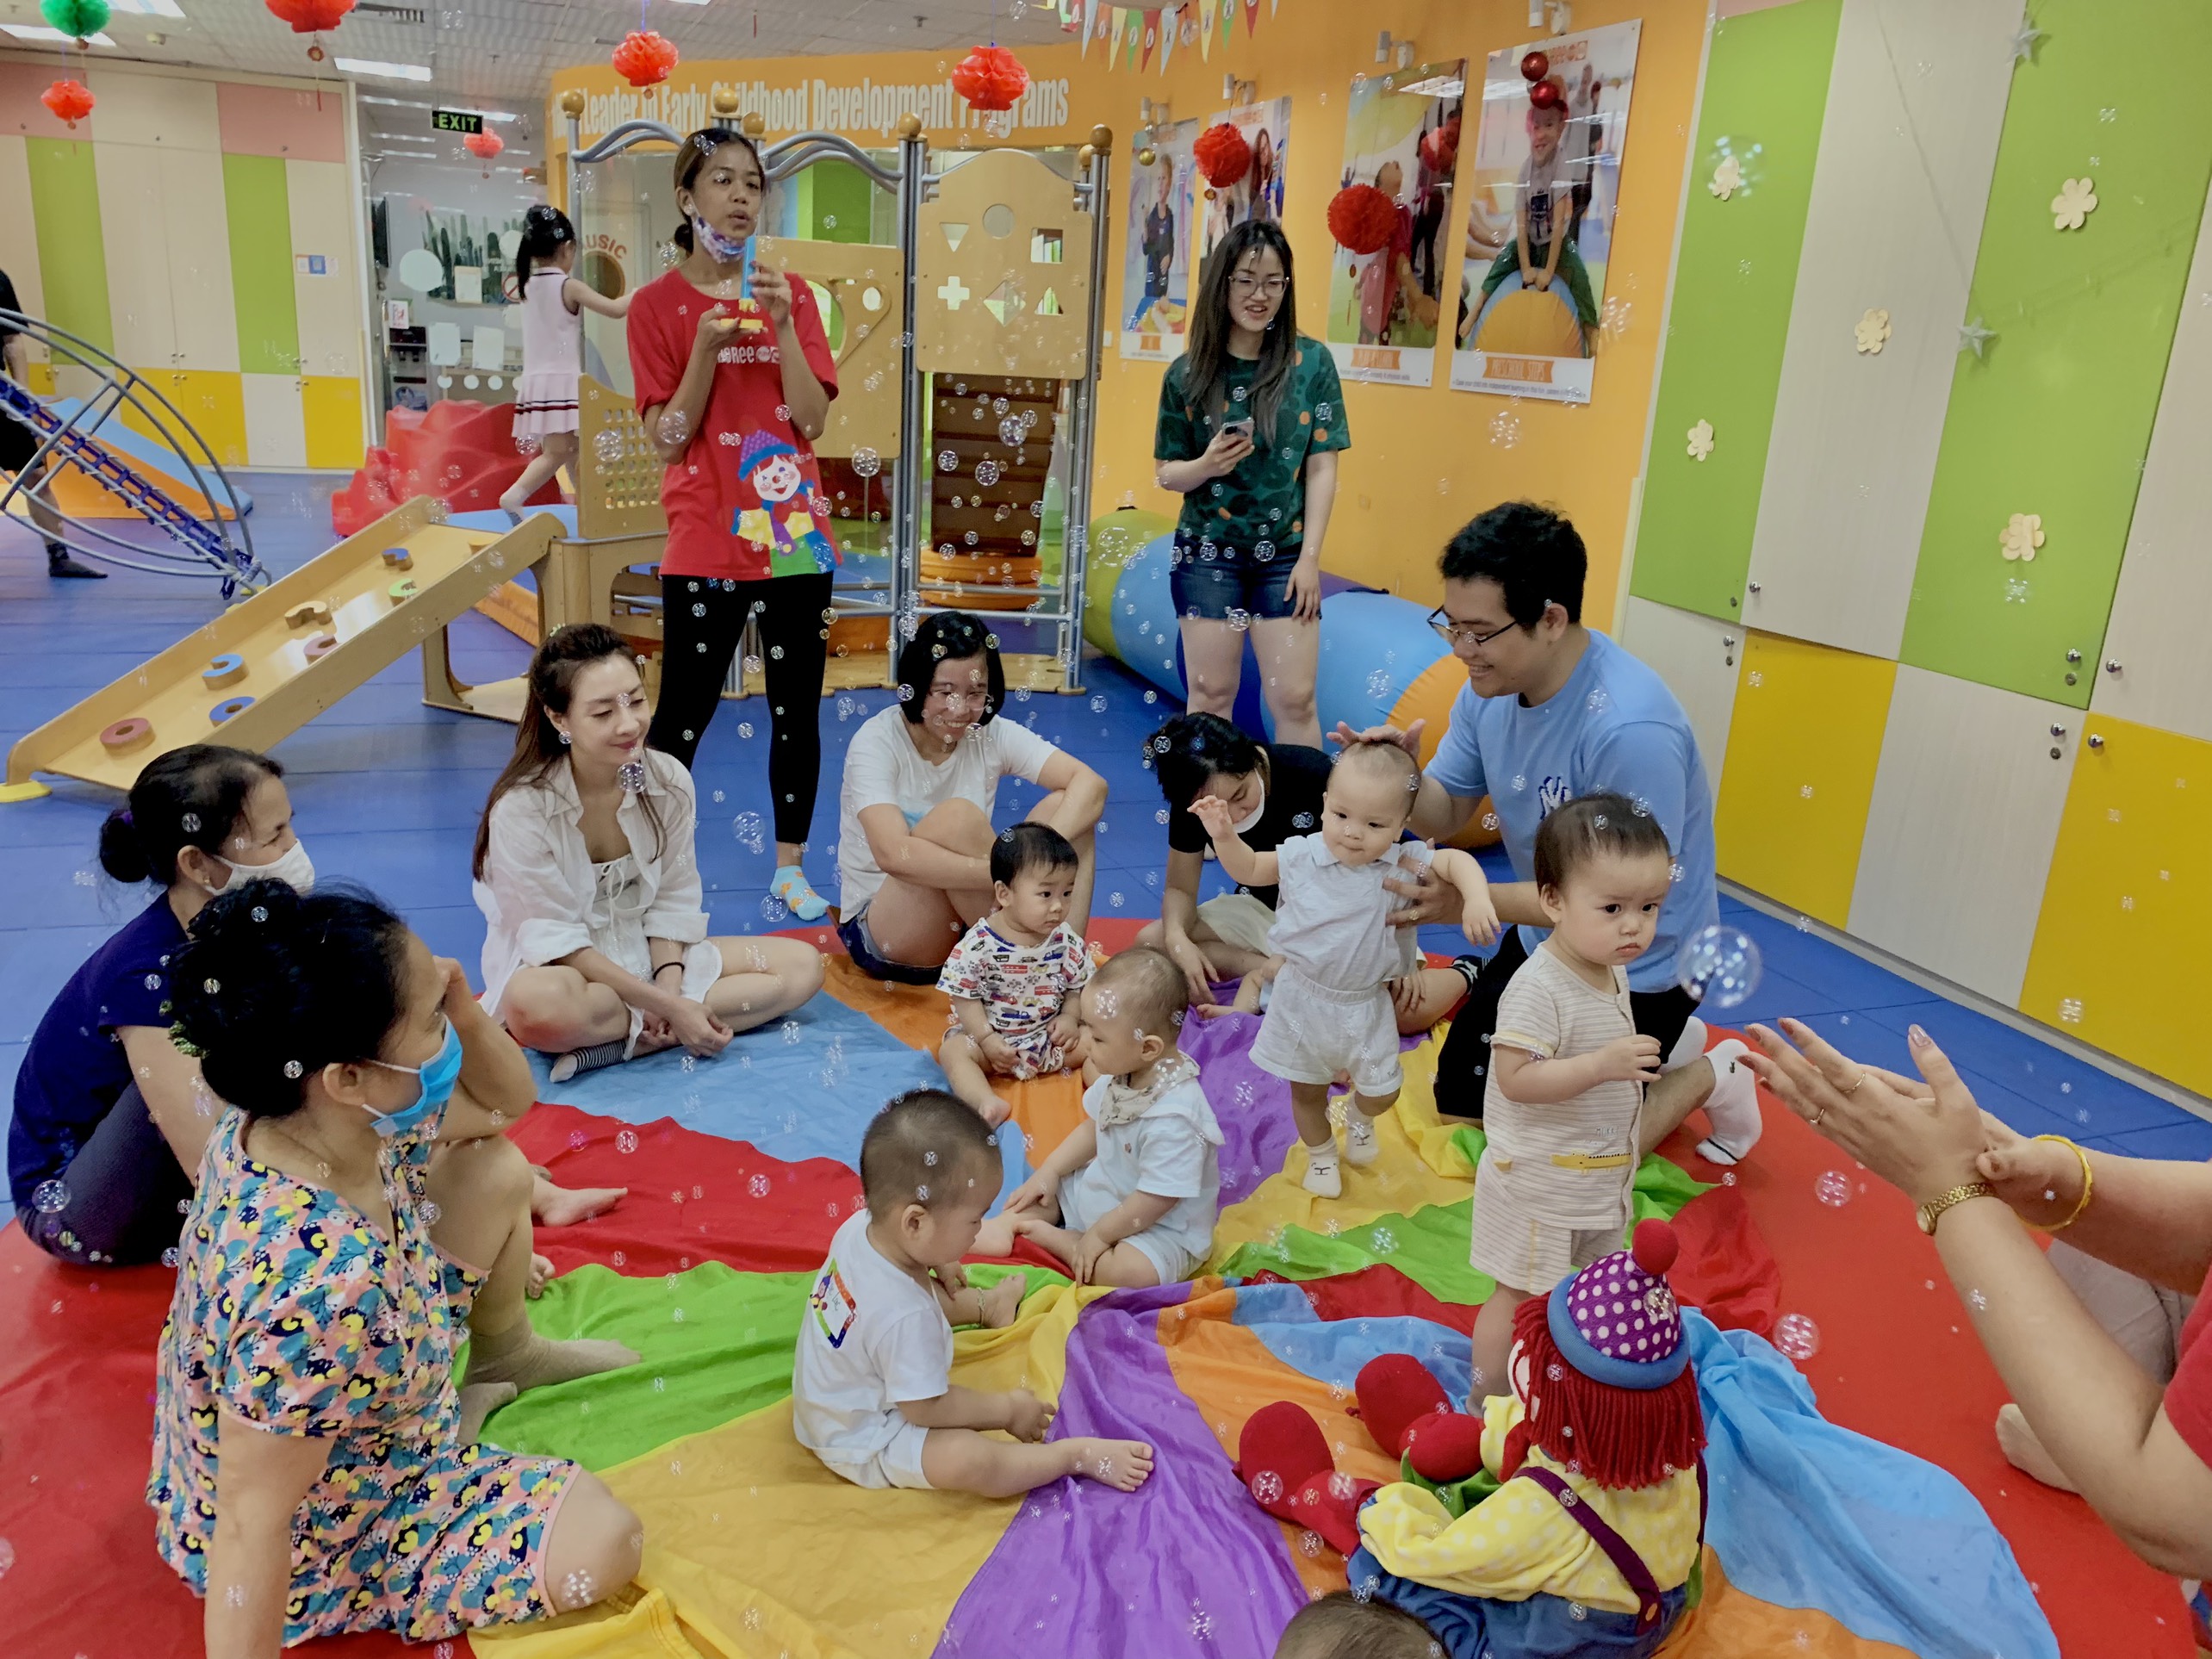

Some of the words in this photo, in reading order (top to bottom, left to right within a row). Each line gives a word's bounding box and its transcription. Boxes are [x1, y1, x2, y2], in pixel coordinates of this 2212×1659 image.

[582, 85, 638, 135] Leader
[661, 83, 707, 134] Early
[812, 77, 954, 139] Development
[438, 113, 477, 132] EXIT
[581, 233, 627, 259] USIC
